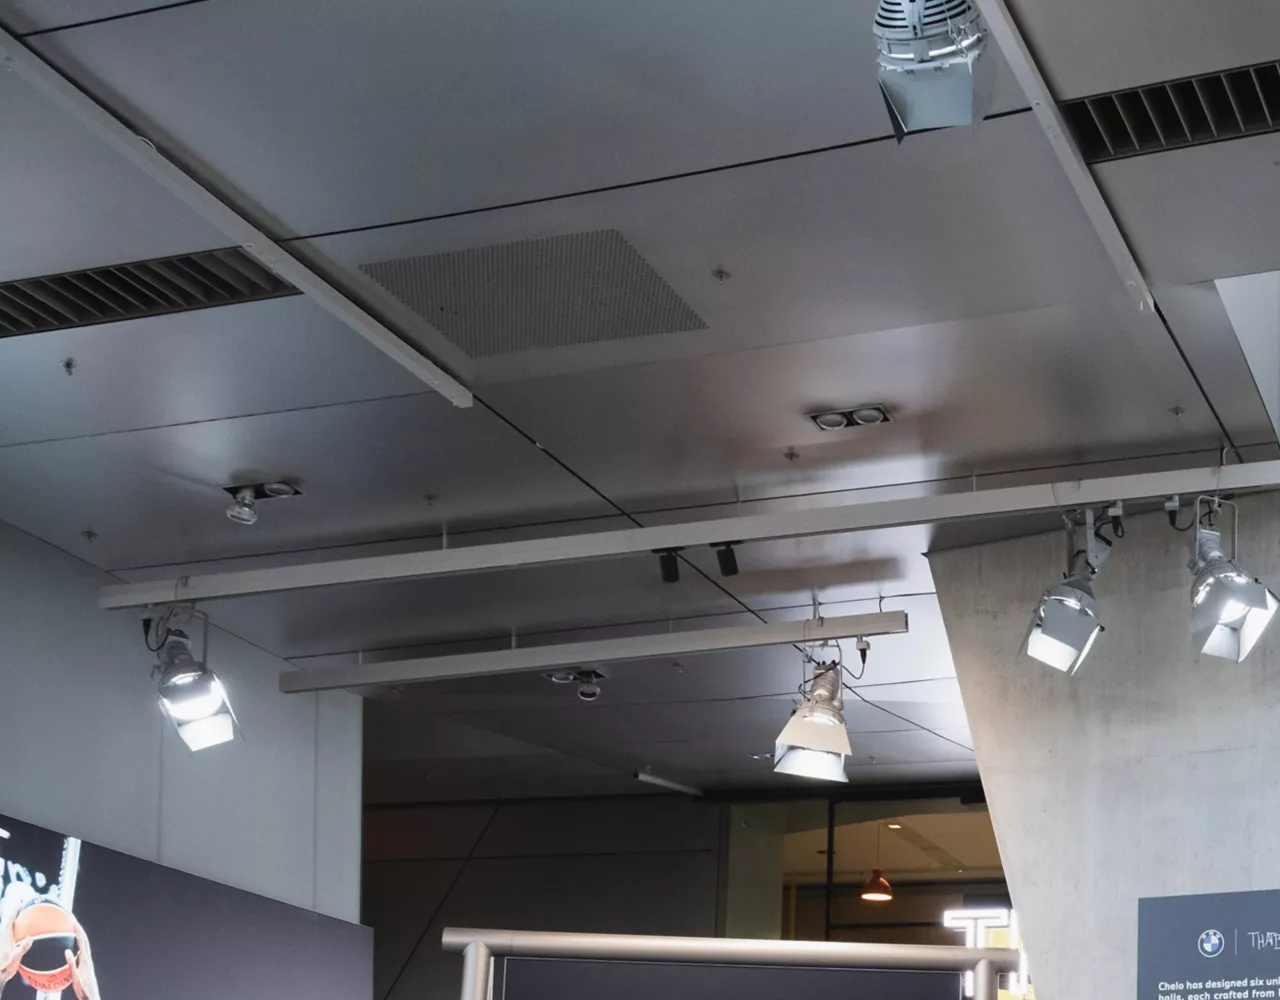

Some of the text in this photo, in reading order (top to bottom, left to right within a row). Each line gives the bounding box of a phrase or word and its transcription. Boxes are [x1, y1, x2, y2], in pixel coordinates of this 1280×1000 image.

[1158, 982, 1184, 990] Chelo
[1186, 980, 1203, 989] has
[1205, 978, 1248, 989] designed
[1250, 977, 1264, 986] six
[1188, 992, 1210, 1000] each
[1214, 990, 1248, 1000] crafted
[1252, 989, 1274, 998] from
